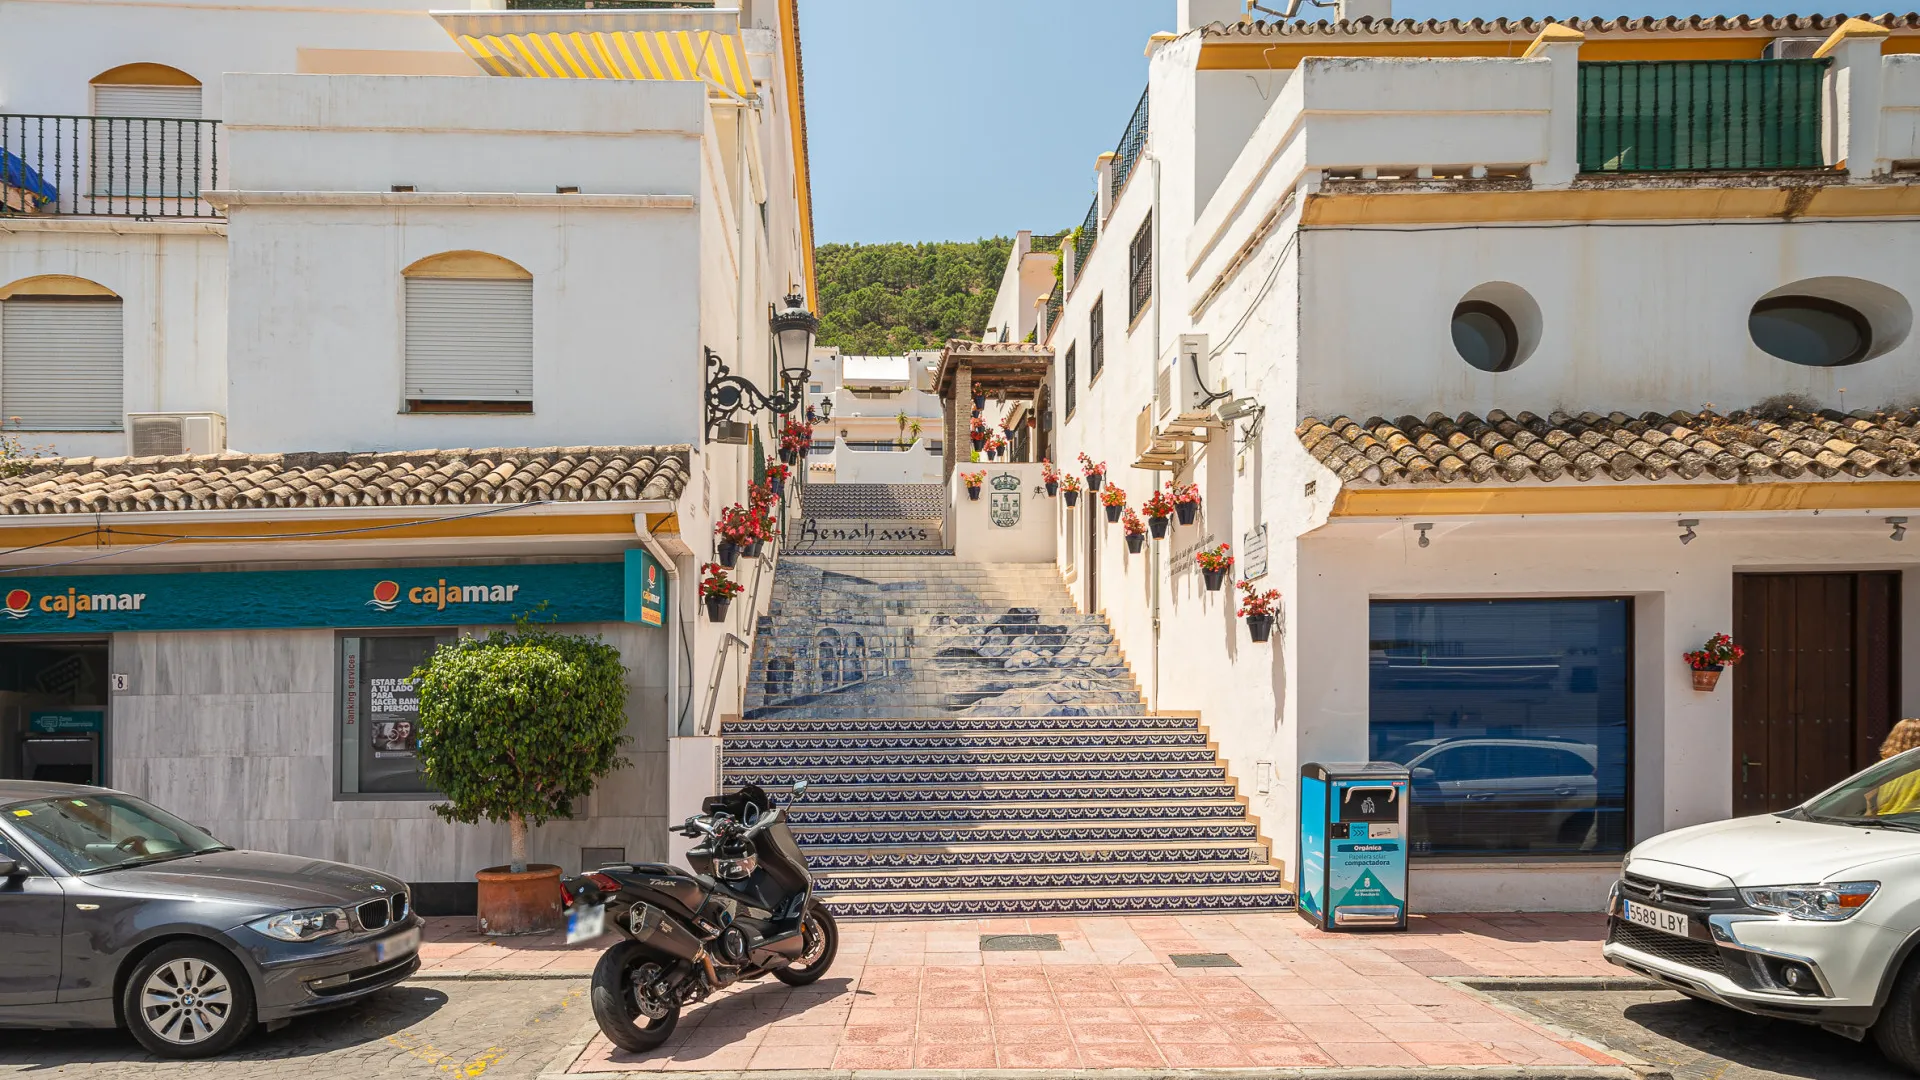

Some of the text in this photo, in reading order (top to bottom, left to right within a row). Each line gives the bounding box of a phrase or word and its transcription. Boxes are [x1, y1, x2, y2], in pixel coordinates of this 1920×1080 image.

[39, 587, 146, 619] cajamar
[408, 578, 519, 610] cajamar
[117, 675, 124, 689] 8
[346, 654, 356, 725] banking services
[371, 678, 396, 686] ESTAR
[371, 698, 397, 706] HACER
[1630, 904, 1684, 933] 5589 LBY
